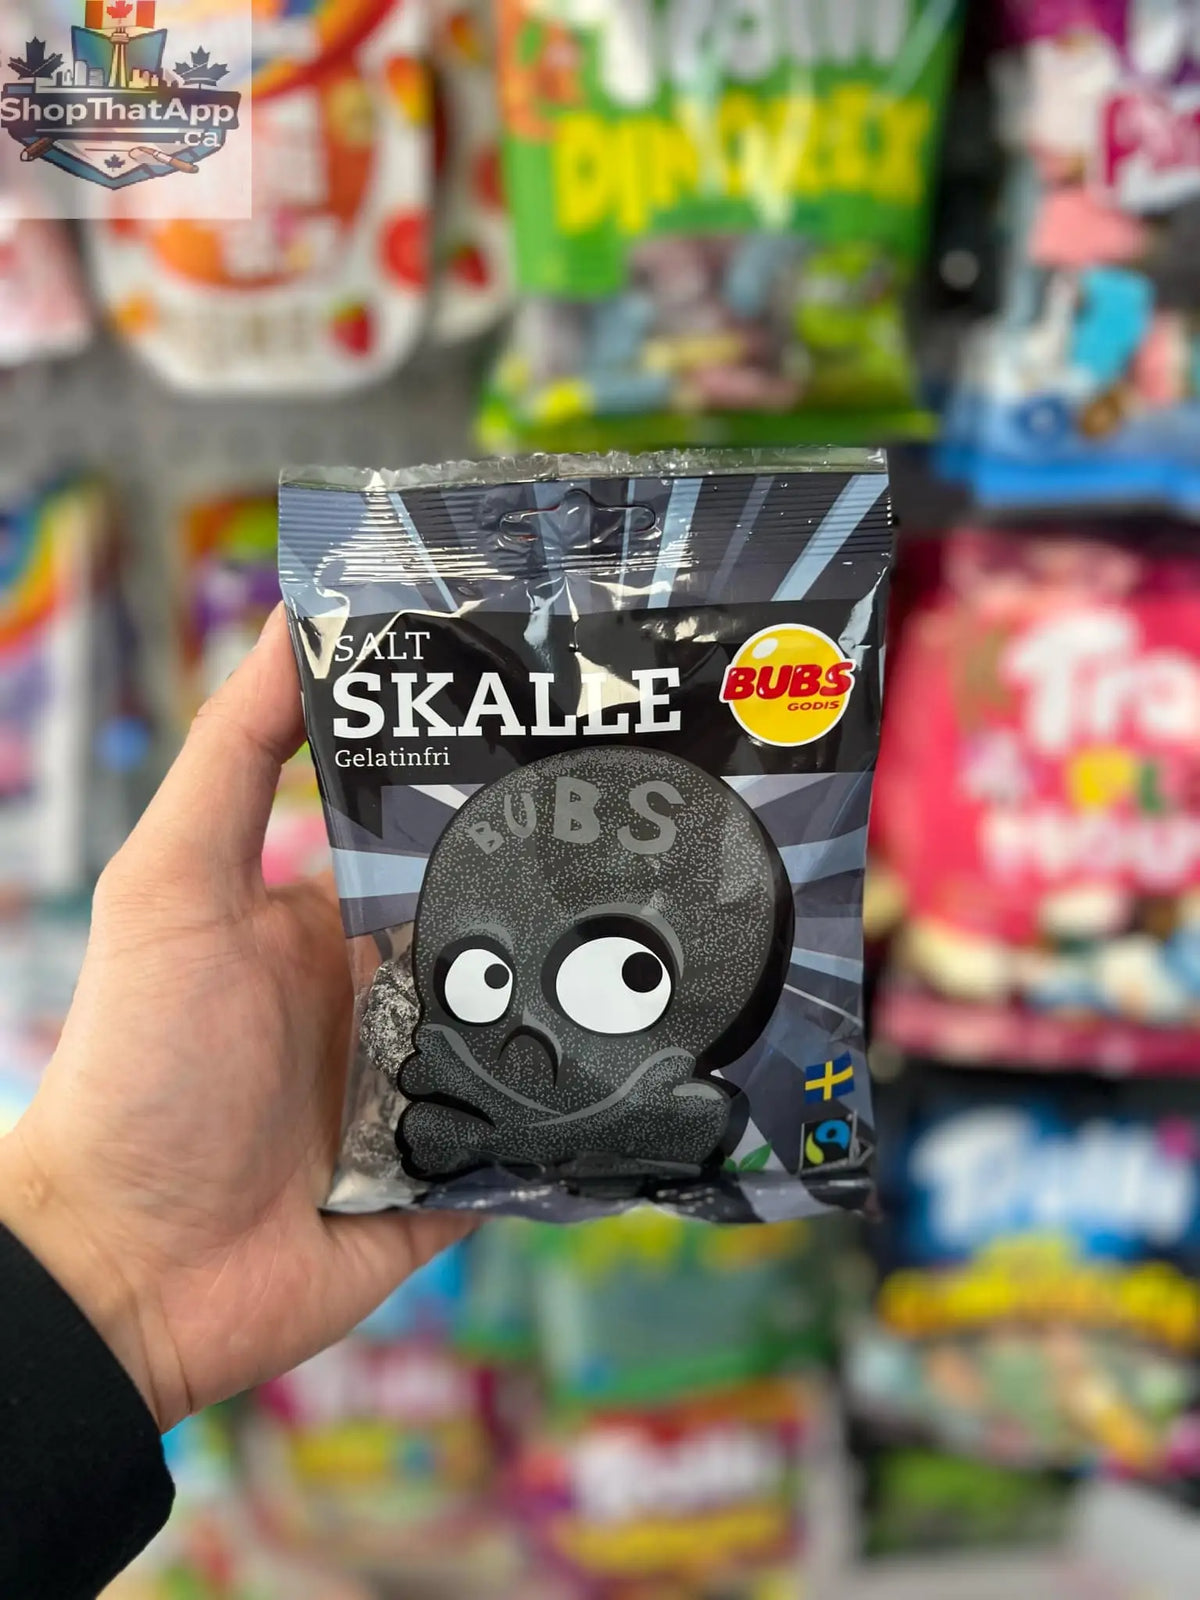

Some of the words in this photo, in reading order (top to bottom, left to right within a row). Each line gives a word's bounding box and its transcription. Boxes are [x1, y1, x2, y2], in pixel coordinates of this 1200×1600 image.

[334, 631, 431, 662] SALT
[723, 662, 853, 701] BUBS
[332, 667, 682, 739] SKALLE
[787, 700, 840, 711] GODIS
[334, 747, 451, 768] Gelatinfri
[467, 776, 686, 855] BUBS
